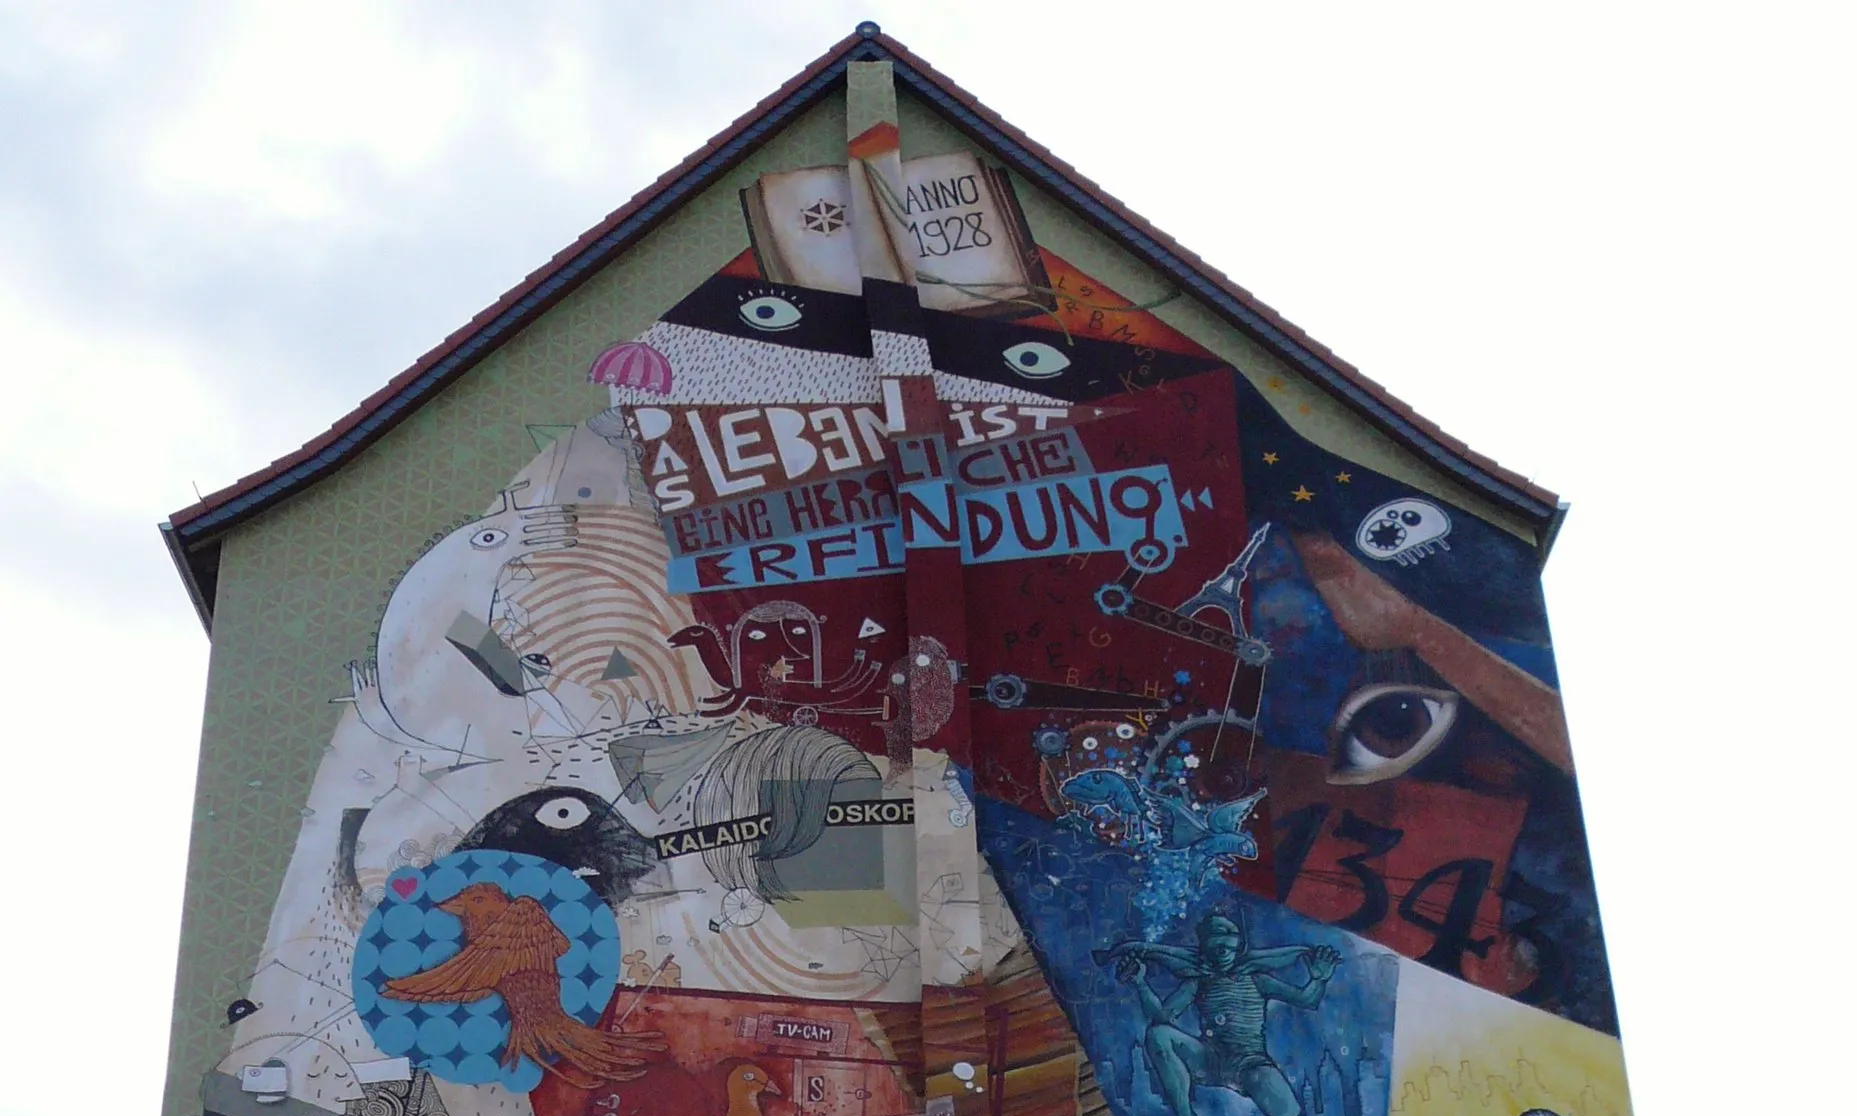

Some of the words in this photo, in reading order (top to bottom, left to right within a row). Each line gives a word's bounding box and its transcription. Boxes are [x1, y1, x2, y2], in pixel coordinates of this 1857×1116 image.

[904, 174, 980, 216] ANNO
[907, 211, 993, 258] 1928
[634, 407, 695, 512] DAS
[686, 377, 906, 497] LEBEN
[773, 1022, 832, 1041] TV-CAM
[811, 1078, 823, 1101] S
